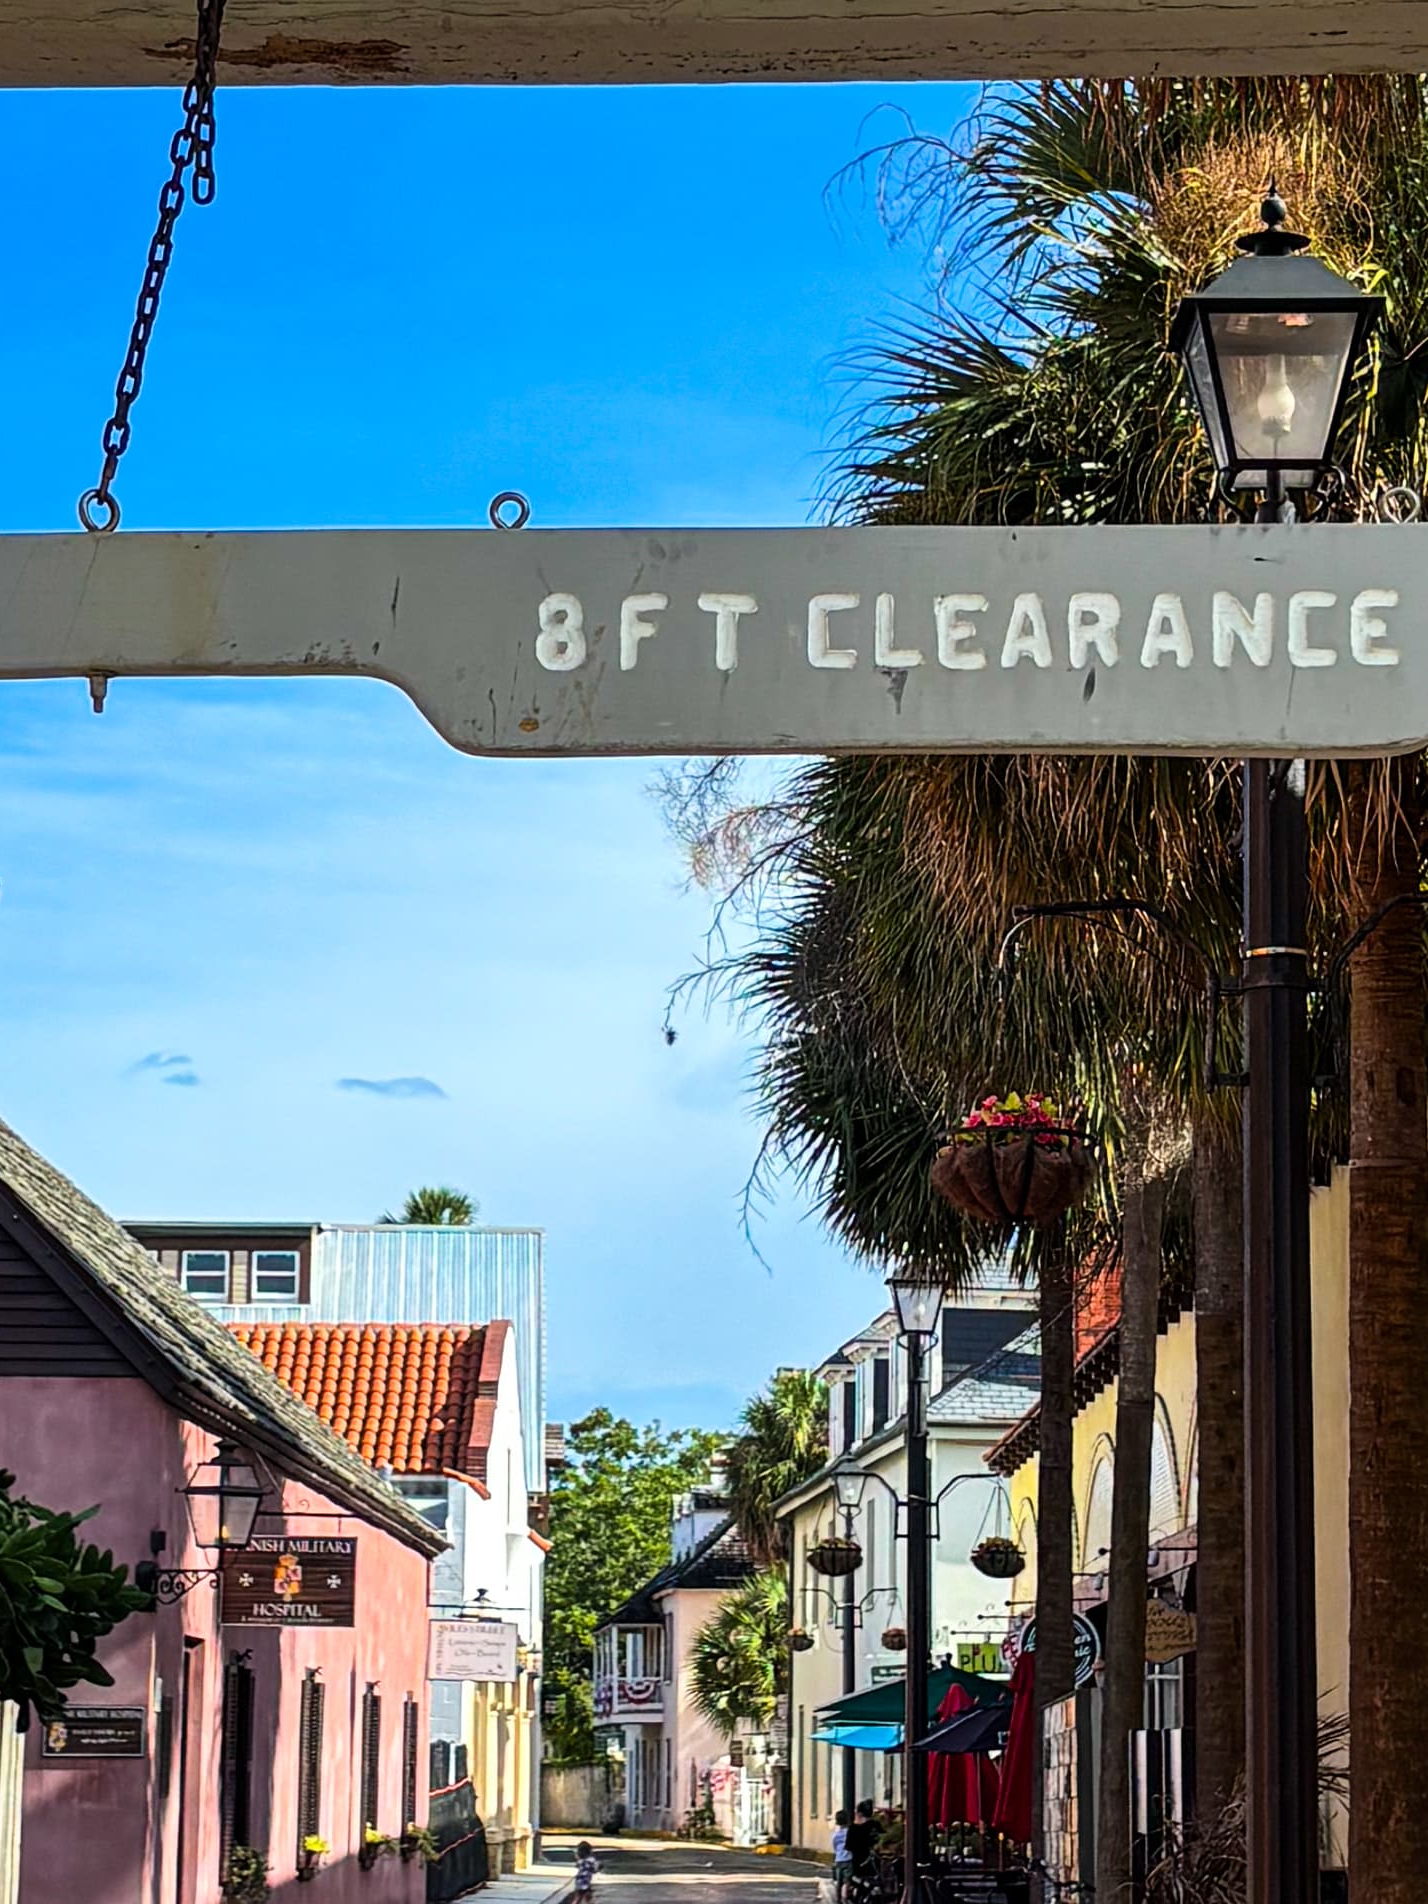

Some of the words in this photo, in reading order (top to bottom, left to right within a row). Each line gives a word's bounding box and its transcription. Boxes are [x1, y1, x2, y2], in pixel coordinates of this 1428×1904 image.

[806, 590, 1402, 671] CLEARANCE
[287, 1539, 352, 1553] MILITARY
[253, 1603, 322, 1617] HOSPITAL
[960, 1654, 1003, 1673] PLU
